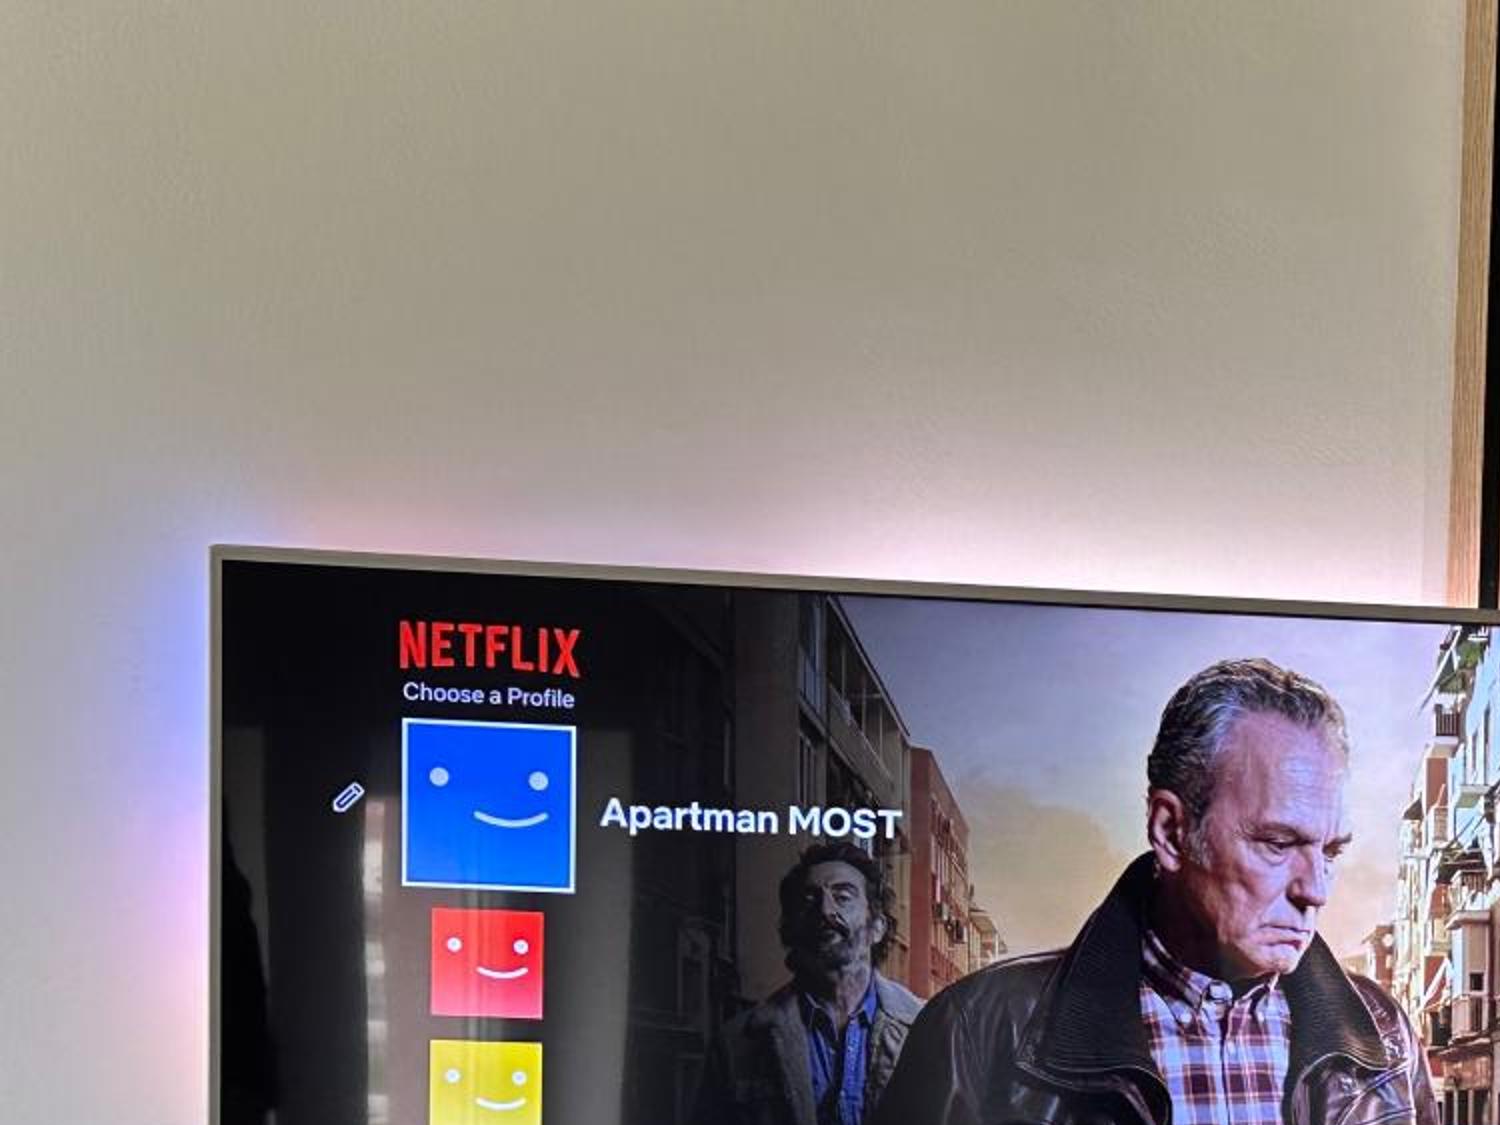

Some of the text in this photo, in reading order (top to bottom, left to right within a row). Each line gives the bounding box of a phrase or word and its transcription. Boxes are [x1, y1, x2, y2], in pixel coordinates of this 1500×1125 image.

[399, 620, 581, 678] NETFLIX
[403, 681, 576, 709] Choose a Profile
[600, 797, 904, 839] Apartman MOST
